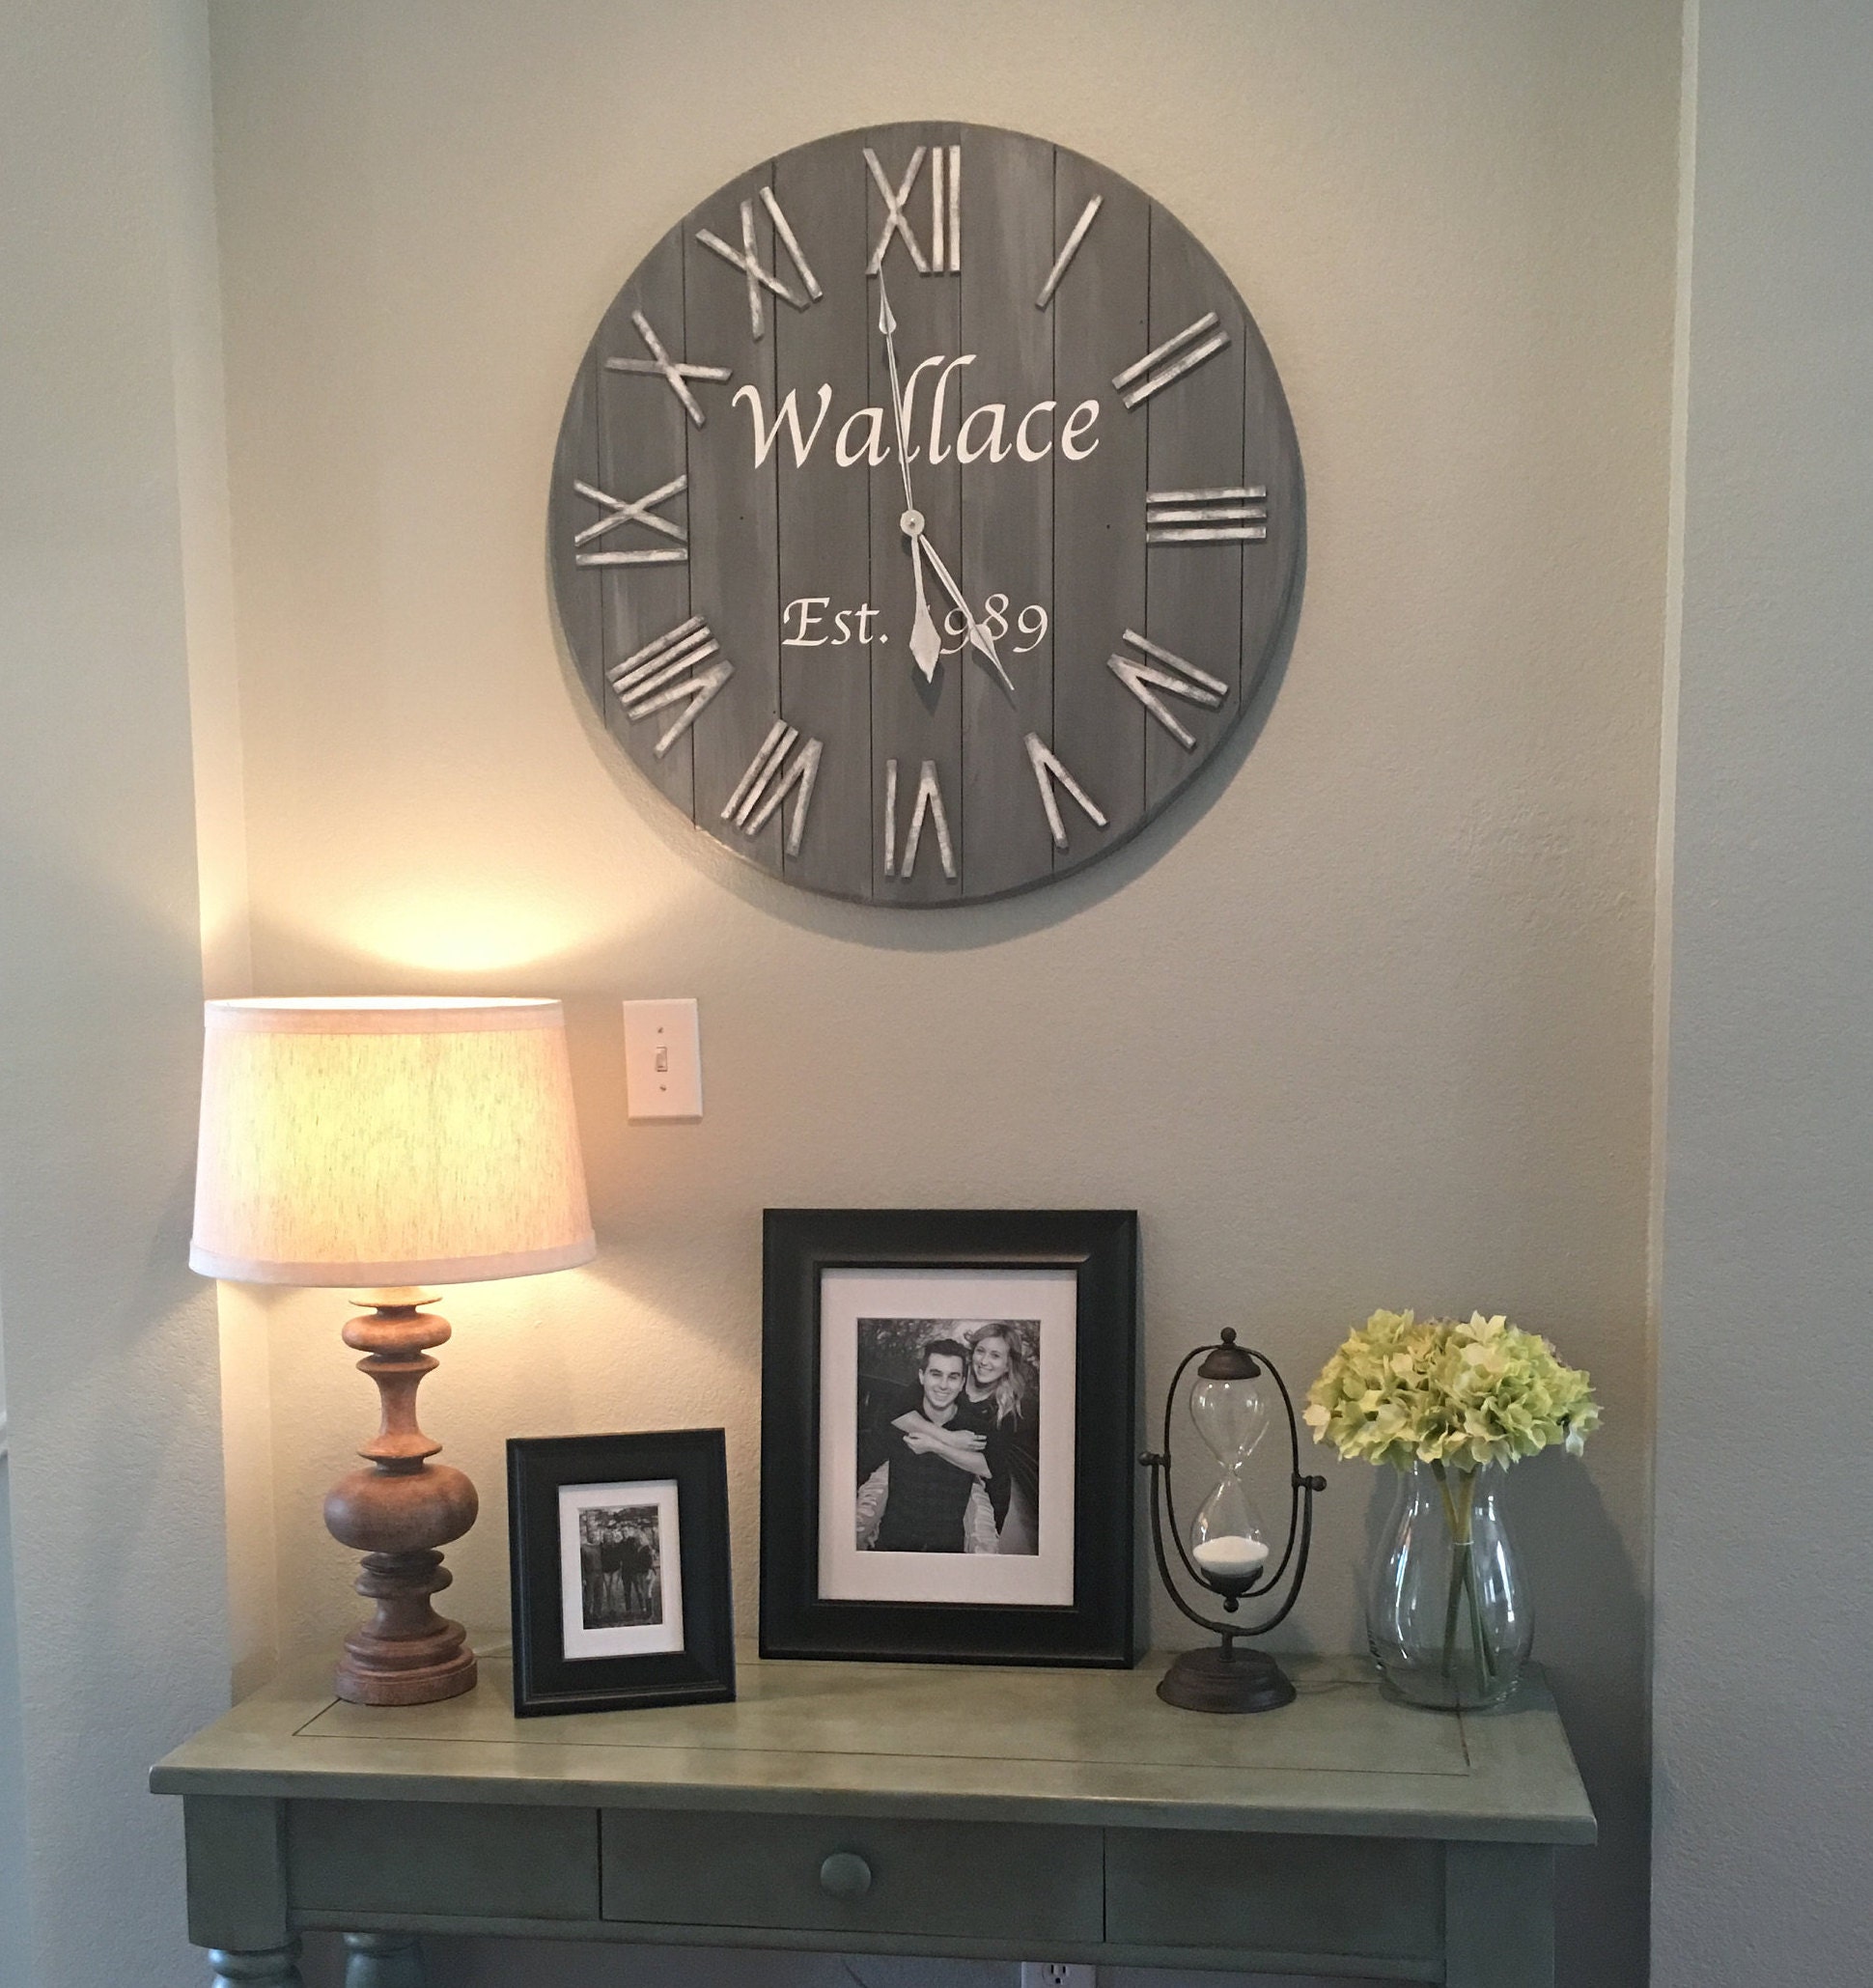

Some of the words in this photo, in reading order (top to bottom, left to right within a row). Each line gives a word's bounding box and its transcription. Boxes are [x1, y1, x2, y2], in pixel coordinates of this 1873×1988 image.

[695, 186, 823, 341] XI
[863, 145, 961, 275] XII
[1036, 194, 1103, 309] I
[605, 309, 734, 429] X
[731, 353, 1102, 469] Wallace
[1111, 311, 1231, 409] II
[573, 474, 688, 568] IX
[1146, 485, 1268, 543] III
[781, 596, 889, 647] Est.
[922, 592, 1049, 654] 989
[607, 614, 735, 760] VIII
[1107, 628, 1229, 750] IV
[720, 718, 825, 858] VII
[884, 759, 957, 880] VI
[1023, 732, 1108, 852] V
